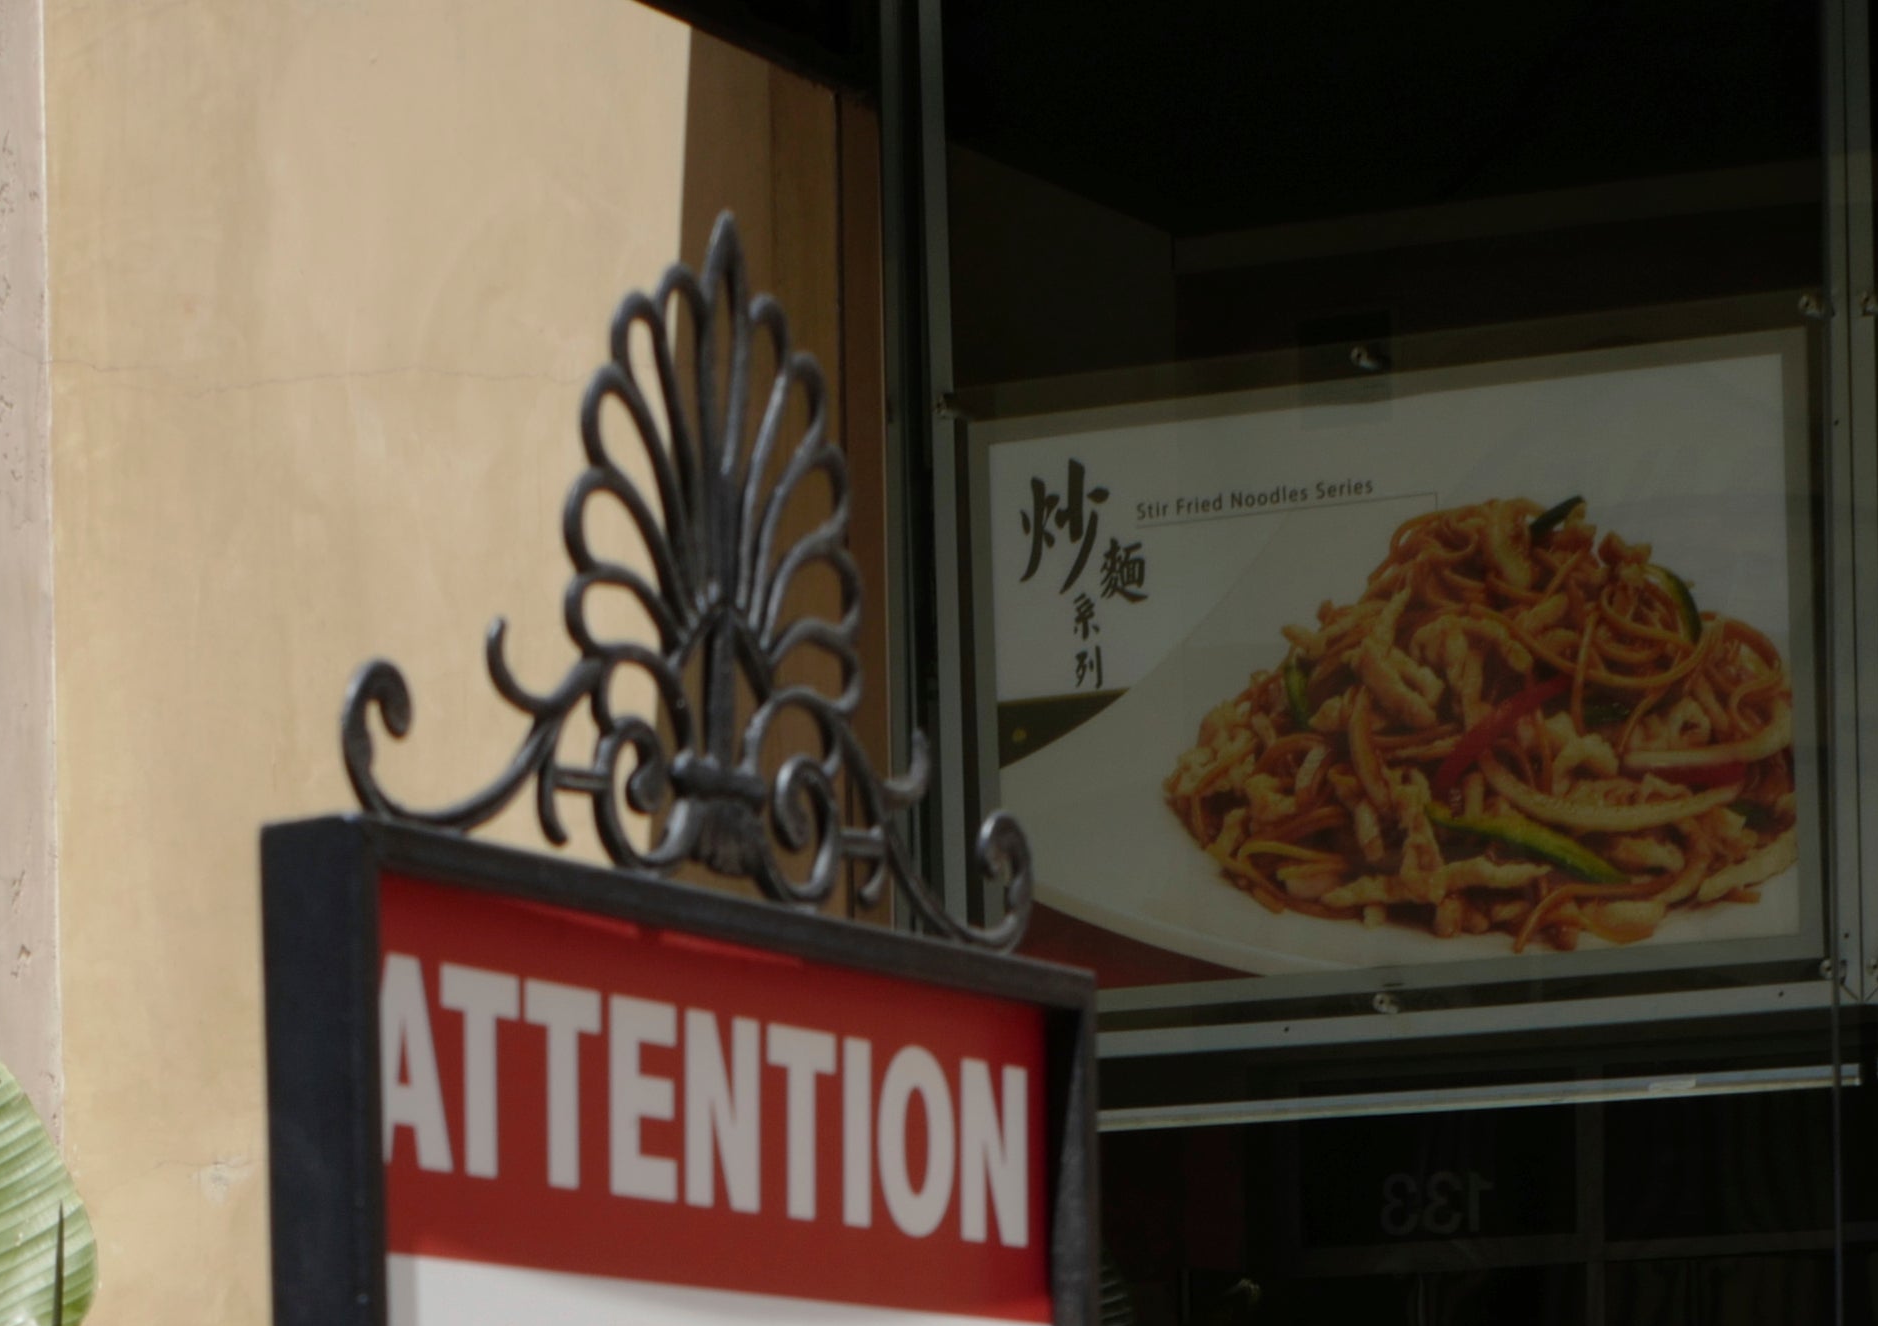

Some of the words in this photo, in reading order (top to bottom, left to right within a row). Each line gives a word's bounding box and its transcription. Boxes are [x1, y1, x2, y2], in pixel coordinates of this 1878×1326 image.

[1136, 502, 1169, 520] Stir
[1176, 494, 1223, 515] Fried
[1231, 486, 1308, 508] Noodles
[1316, 479, 1373, 499] Series
[380, 952, 1028, 1248] ATTENTION
